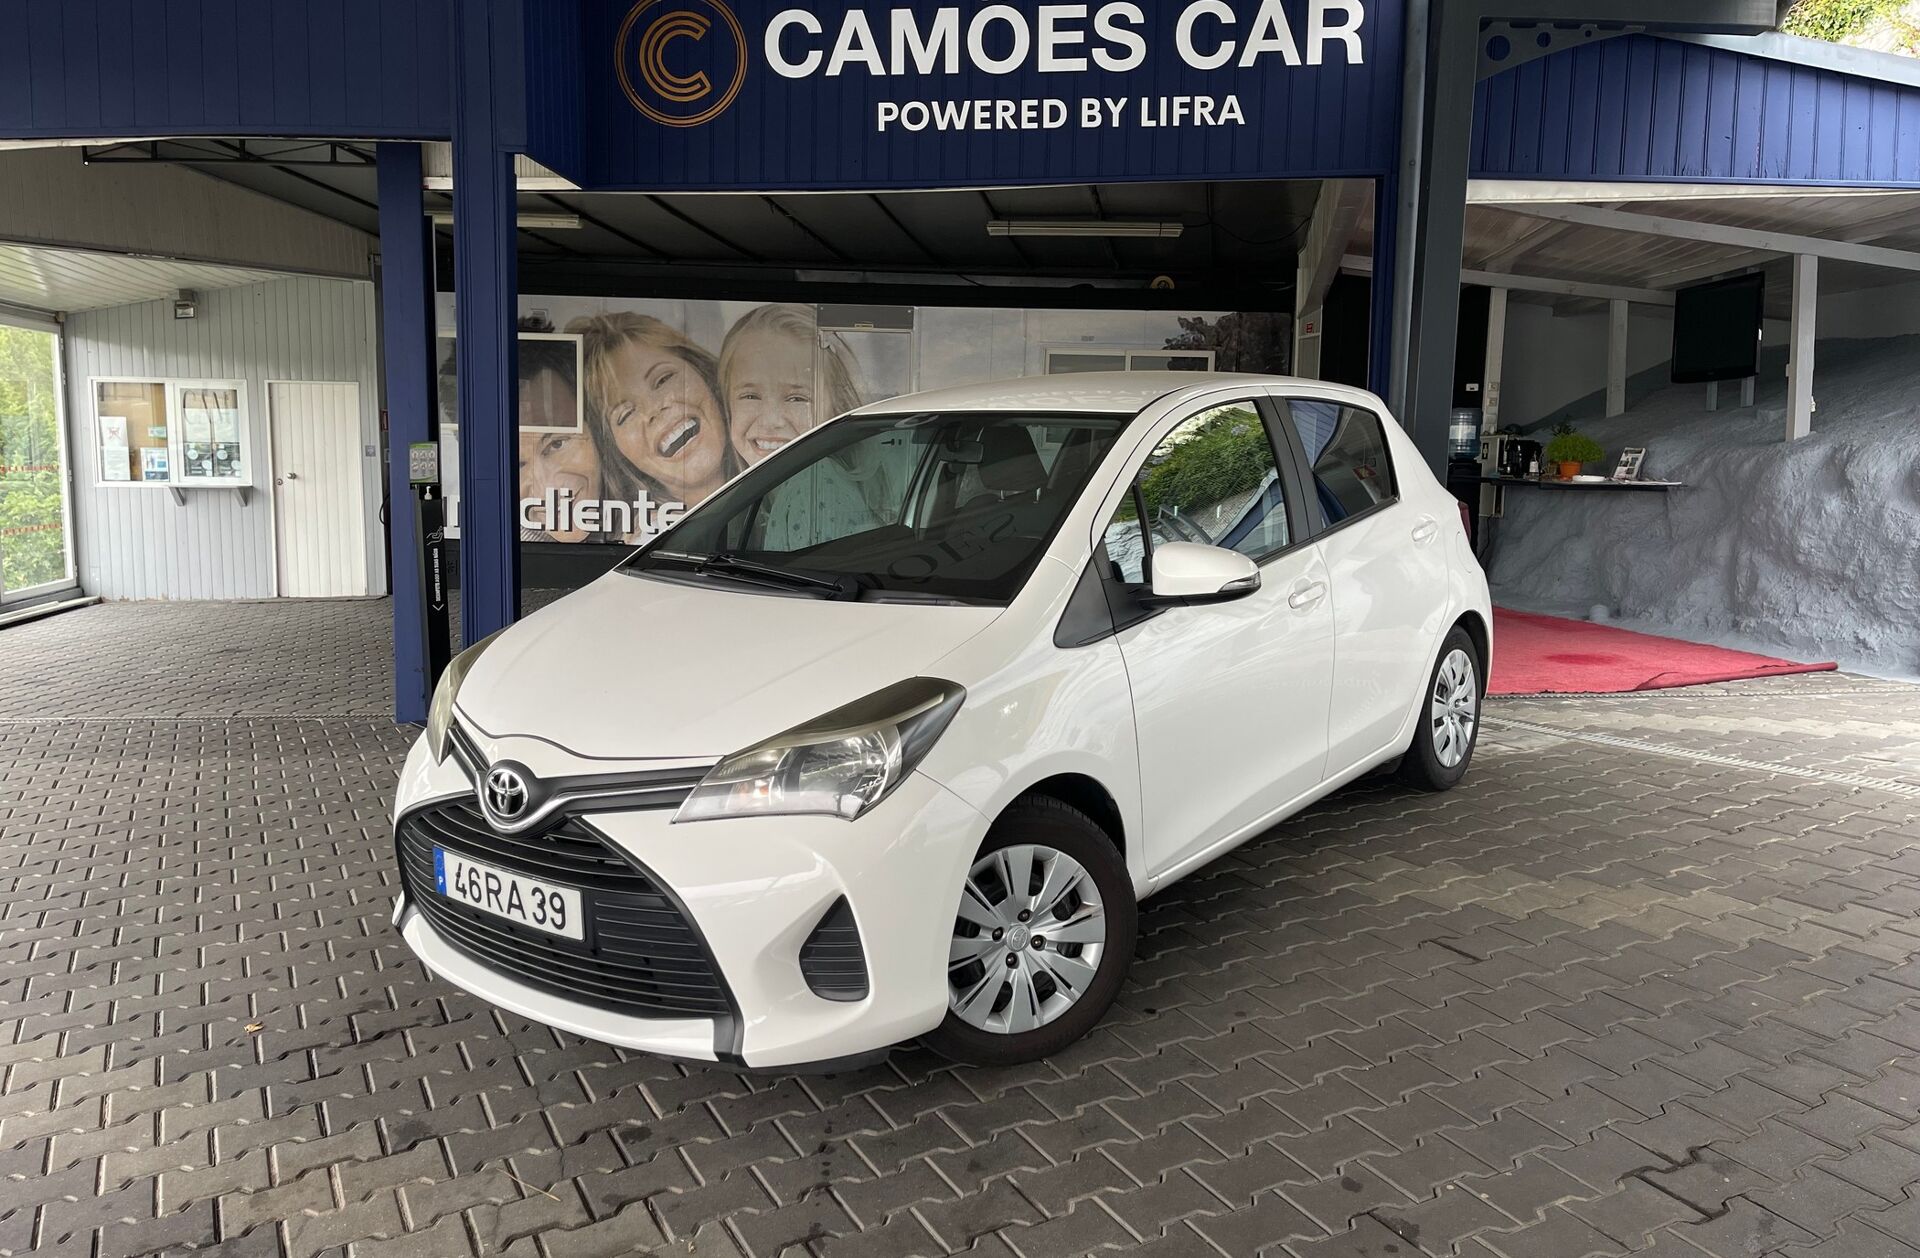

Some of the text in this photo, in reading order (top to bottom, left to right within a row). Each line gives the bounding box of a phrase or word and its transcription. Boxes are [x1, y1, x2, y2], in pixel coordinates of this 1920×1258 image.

[1175, 0, 1364, 70] CAR
[878, 94, 1246, 132] POWERED BY LIFRA
[520, 487, 685, 533] cliente
